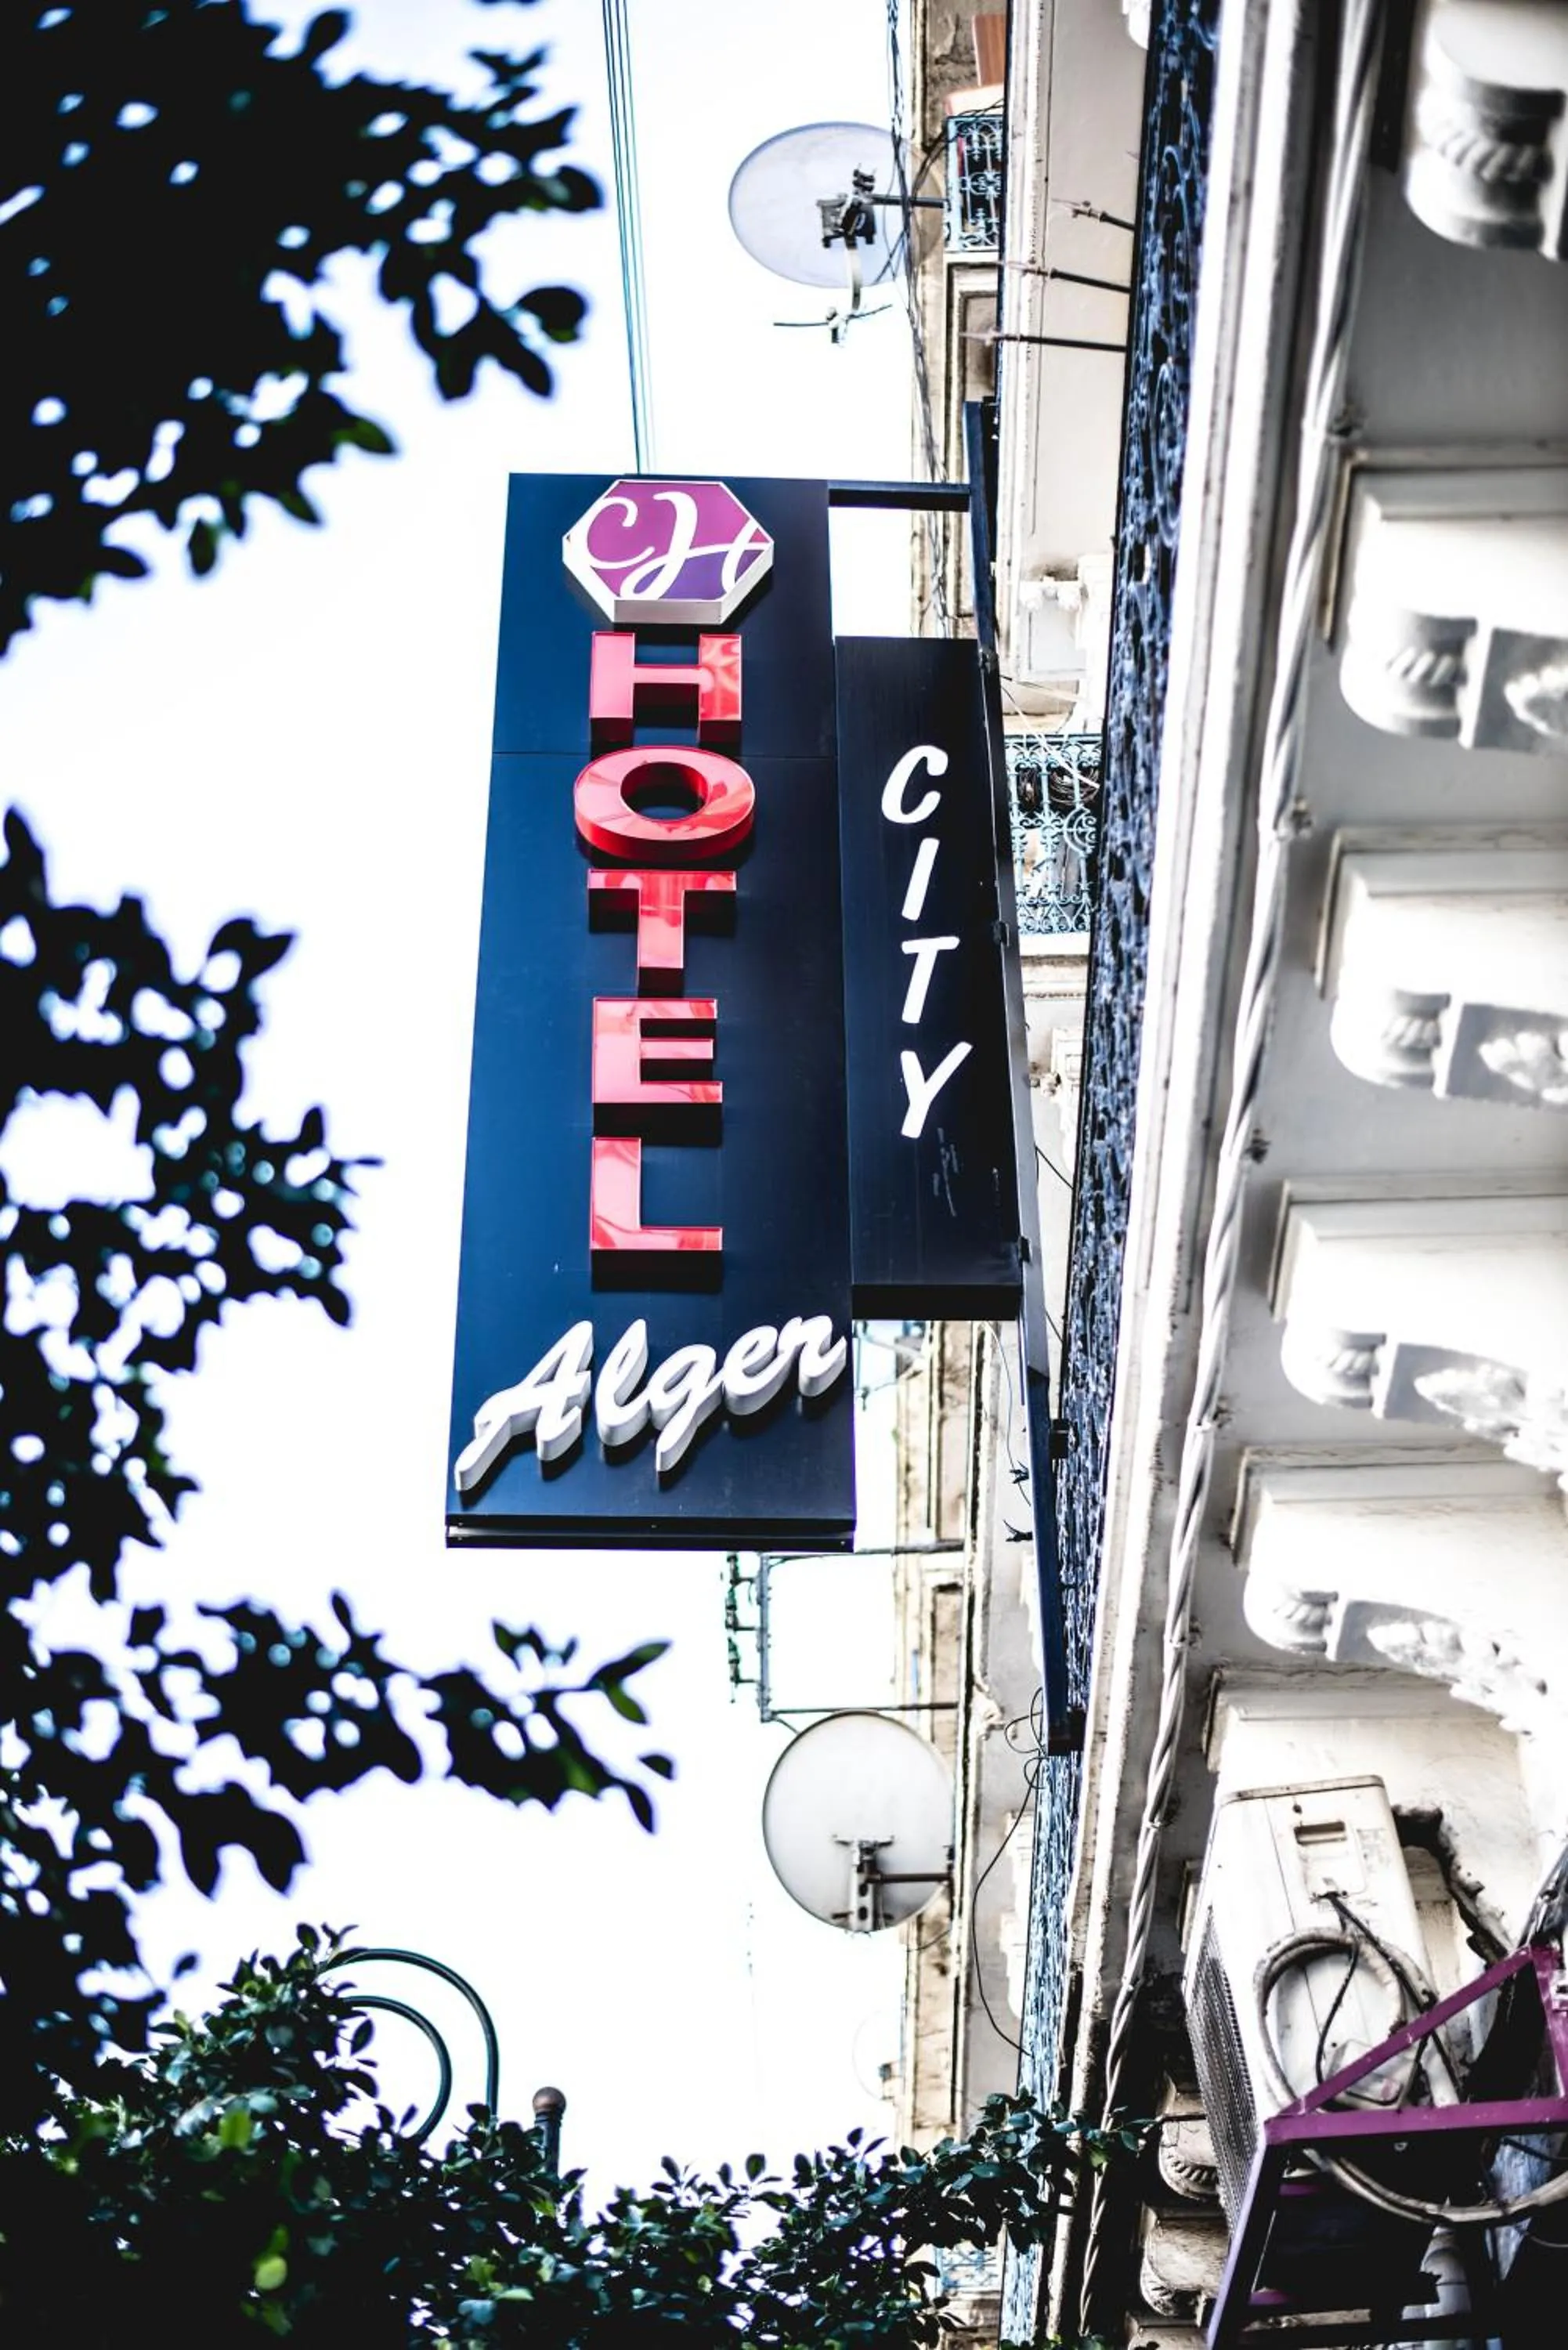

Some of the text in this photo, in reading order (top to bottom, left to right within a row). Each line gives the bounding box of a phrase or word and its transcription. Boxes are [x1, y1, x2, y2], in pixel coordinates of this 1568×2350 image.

[573, 631, 756, 1252] HOTEL
[881, 745, 973, 1139] CITY
[454, 1314, 847, 1488] Alger
